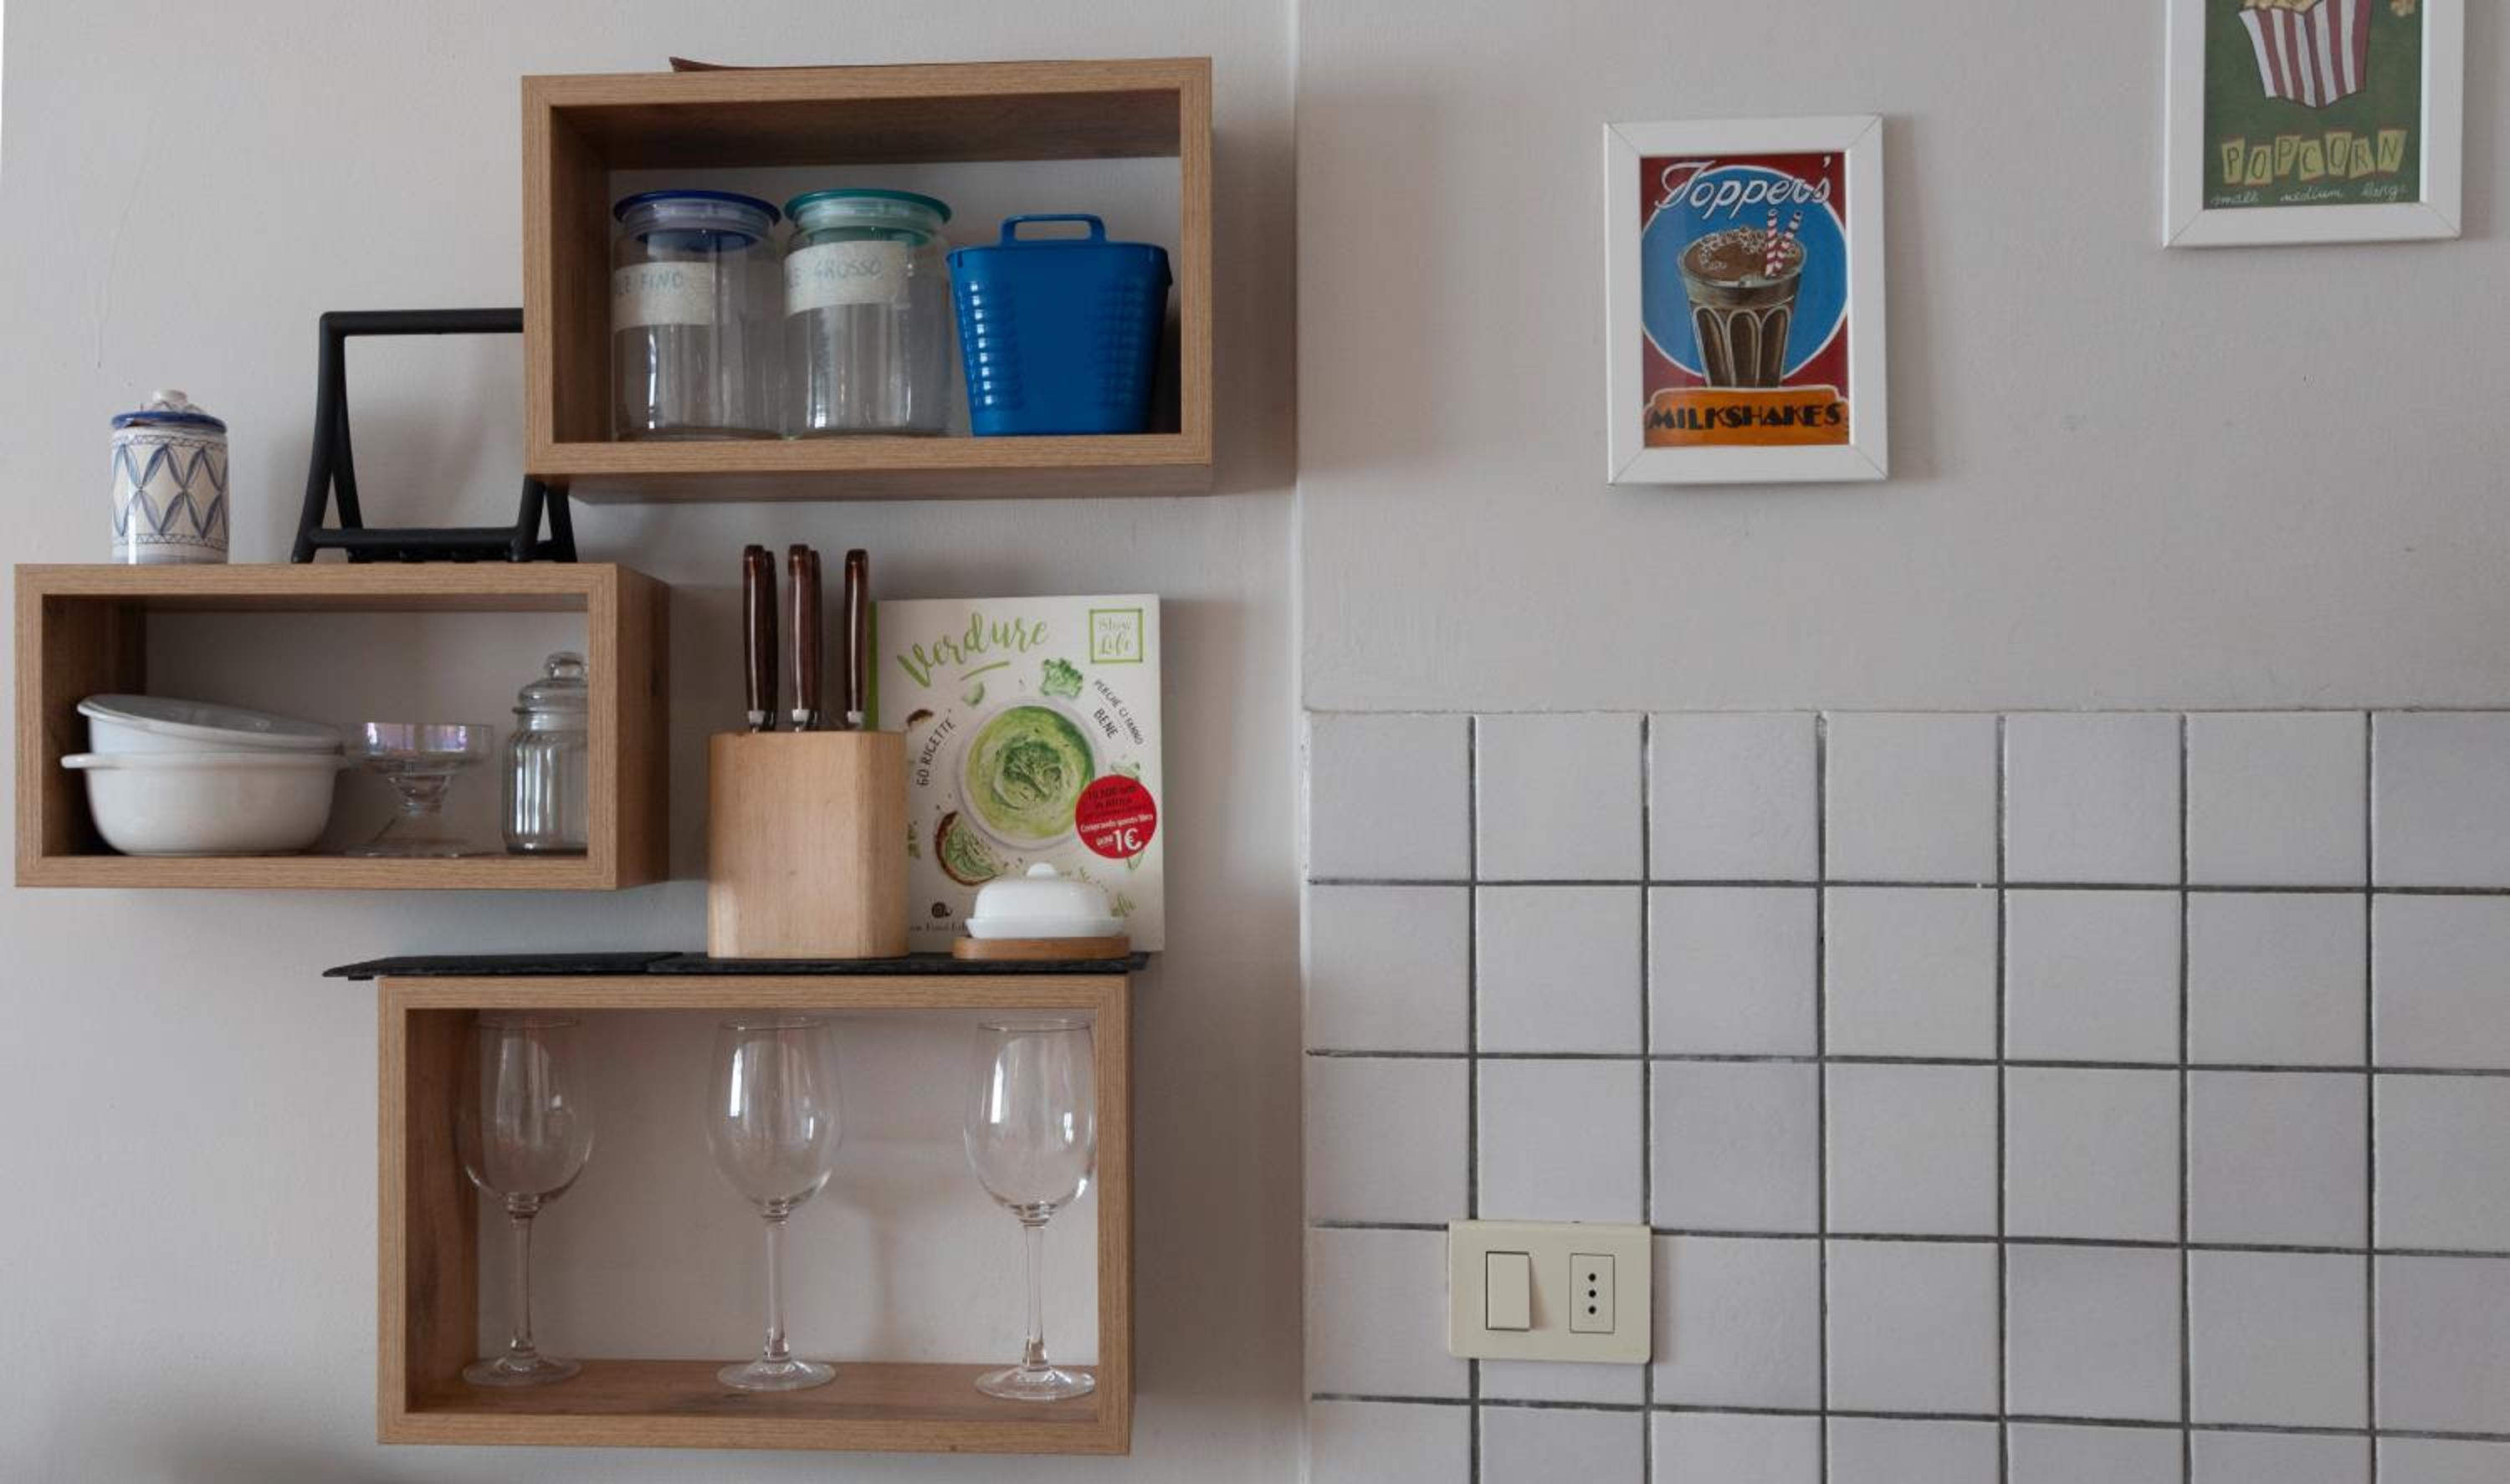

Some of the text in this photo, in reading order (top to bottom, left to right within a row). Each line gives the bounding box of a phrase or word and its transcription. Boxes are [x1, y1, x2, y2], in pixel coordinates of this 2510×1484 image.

[2226, 135, 2400, 180] POPCORN
[1647, 400, 1842, 432] MILKSHAKES
[896, 612, 1048, 688] Verdure
[1093, 708, 1119, 739] BENE
[915, 719, 956, 786] 60 RICETTE
[1112, 827, 1143, 853] 1€
